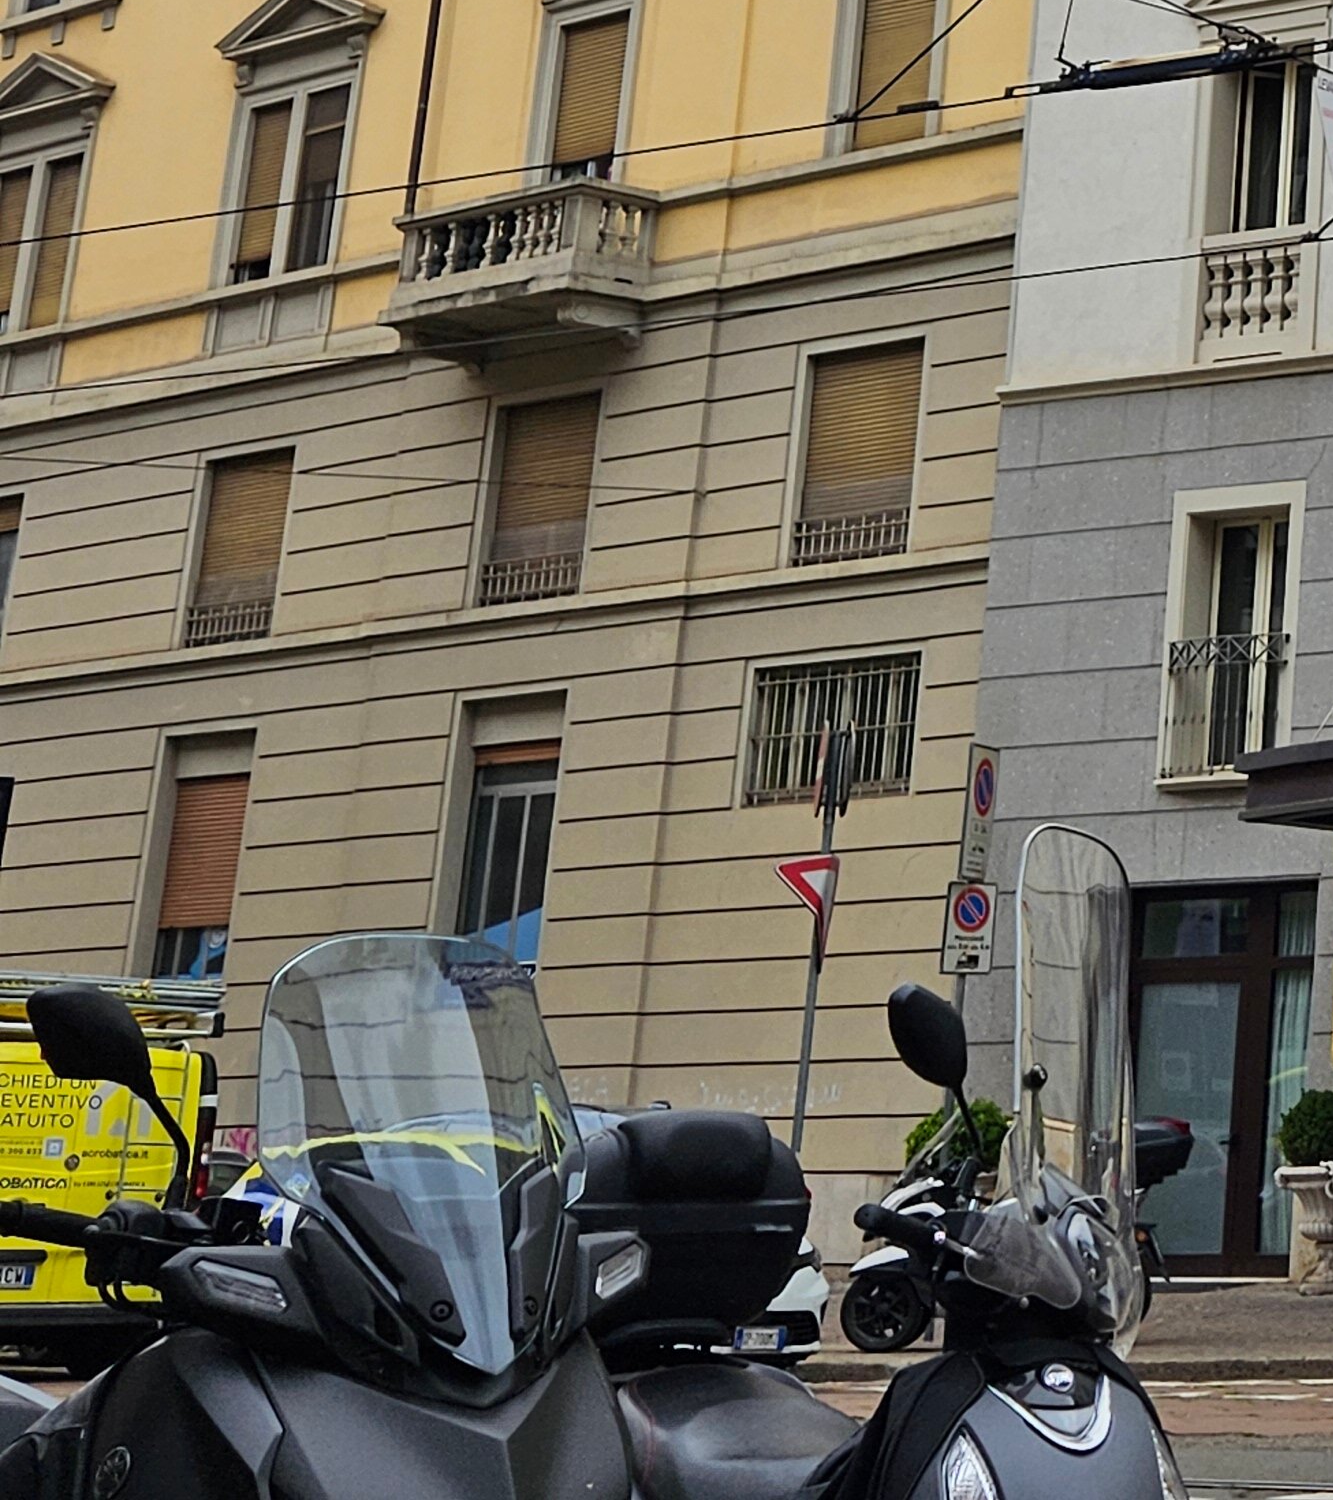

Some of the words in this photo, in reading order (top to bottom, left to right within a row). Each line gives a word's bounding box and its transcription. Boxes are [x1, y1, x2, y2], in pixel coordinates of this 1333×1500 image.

[1, 1093, 103, 1110] EVENTIVO
[1, 1112, 75, 1128] ATUITO
[81, 1148, 149, 1159] acrobatca.it
[0, 1267, 24, 1284] CW
